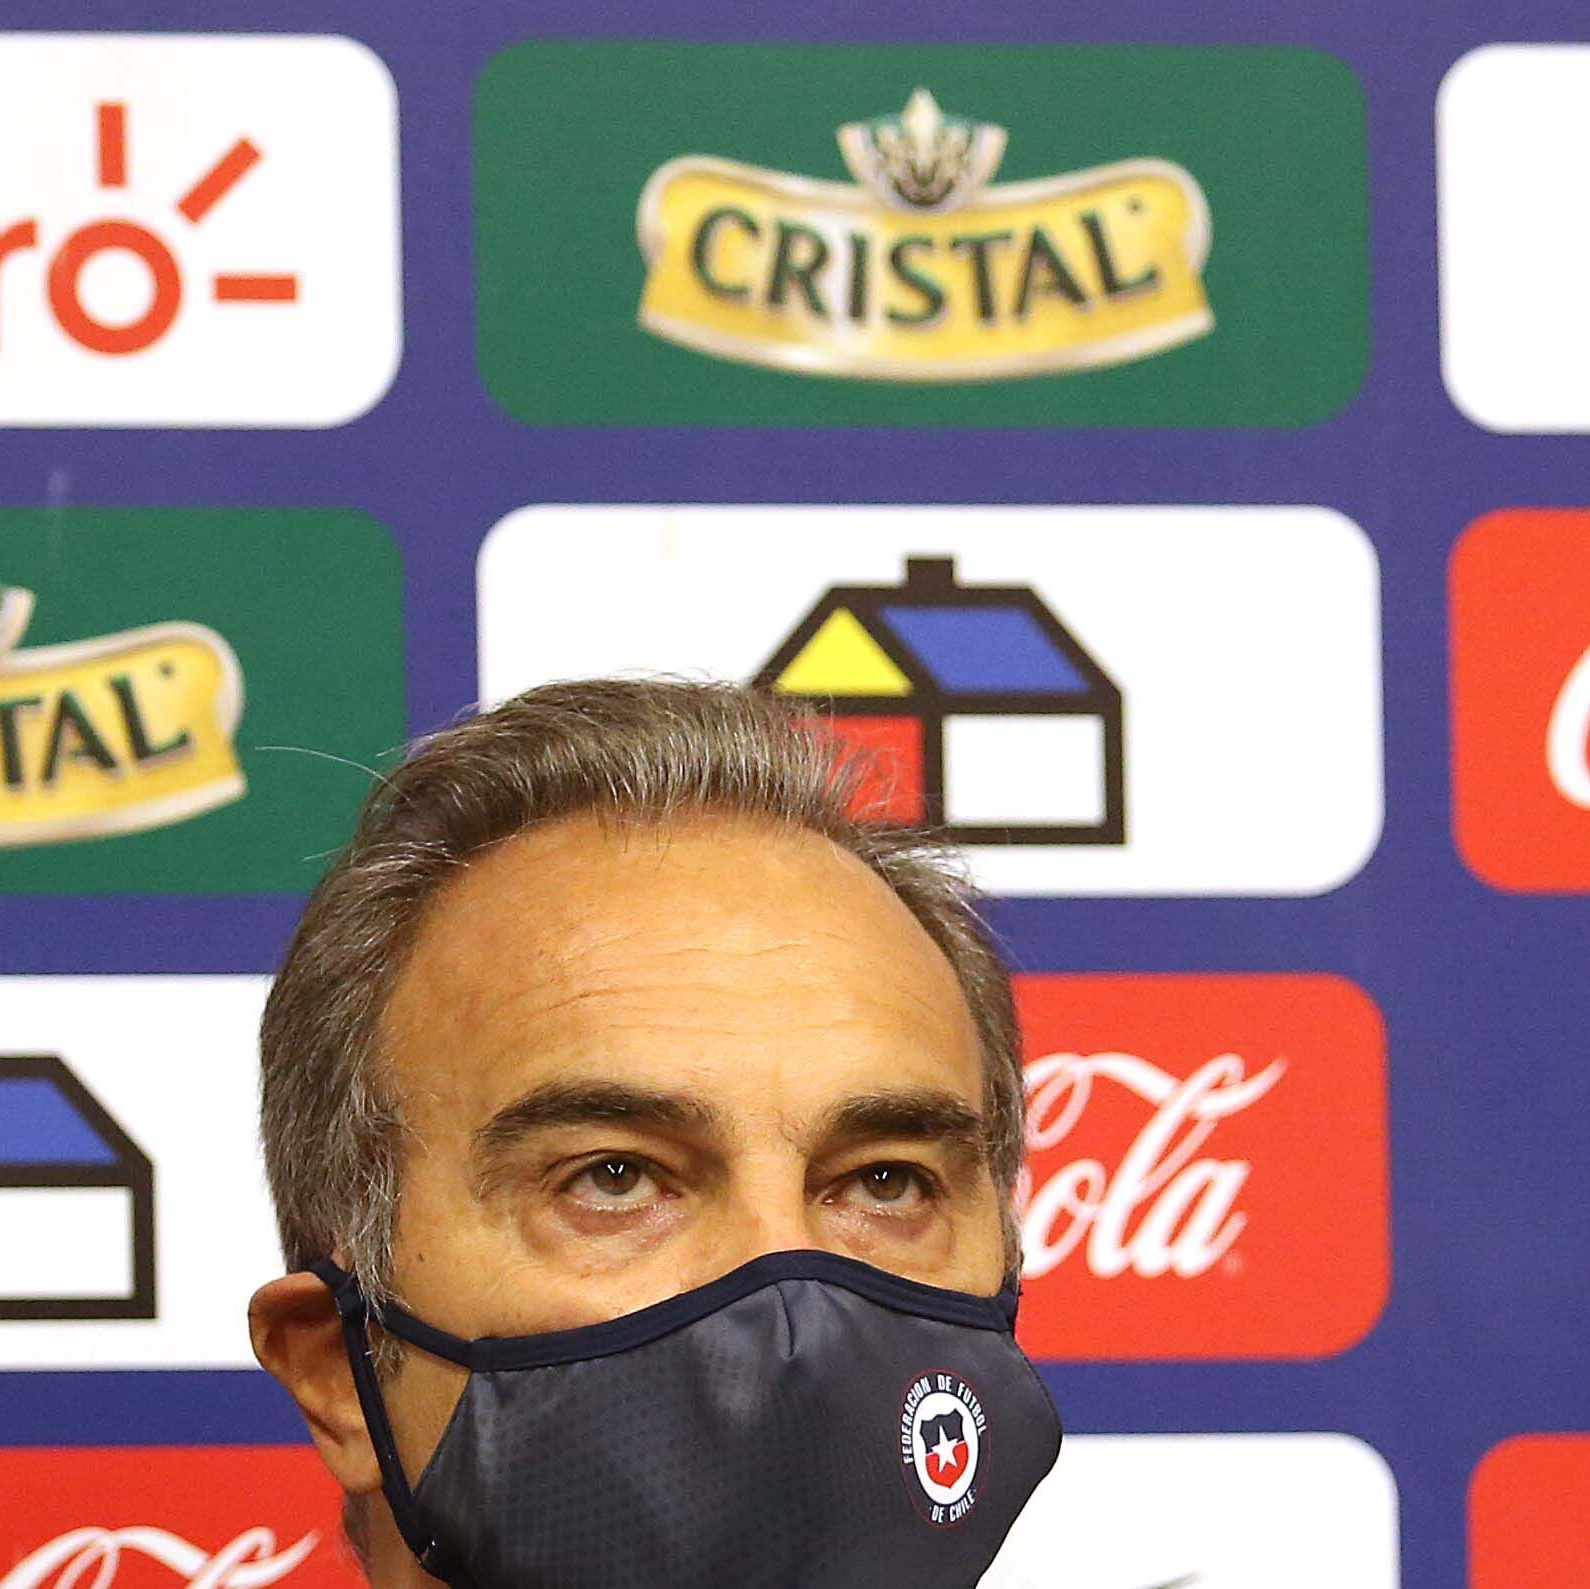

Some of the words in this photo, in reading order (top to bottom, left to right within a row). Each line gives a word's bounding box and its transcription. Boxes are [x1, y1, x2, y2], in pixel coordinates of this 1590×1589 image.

[688, 202, 1165, 328] CRISTAL
[901, 1376, 931, 1464] FEDERACION
[937, 1374, 952, 1392] DE
[957, 1382, 987, 1435] FUTBOL
[931, 1506, 944, 1522] DE
[949, 1488, 975, 1522] CHILE
